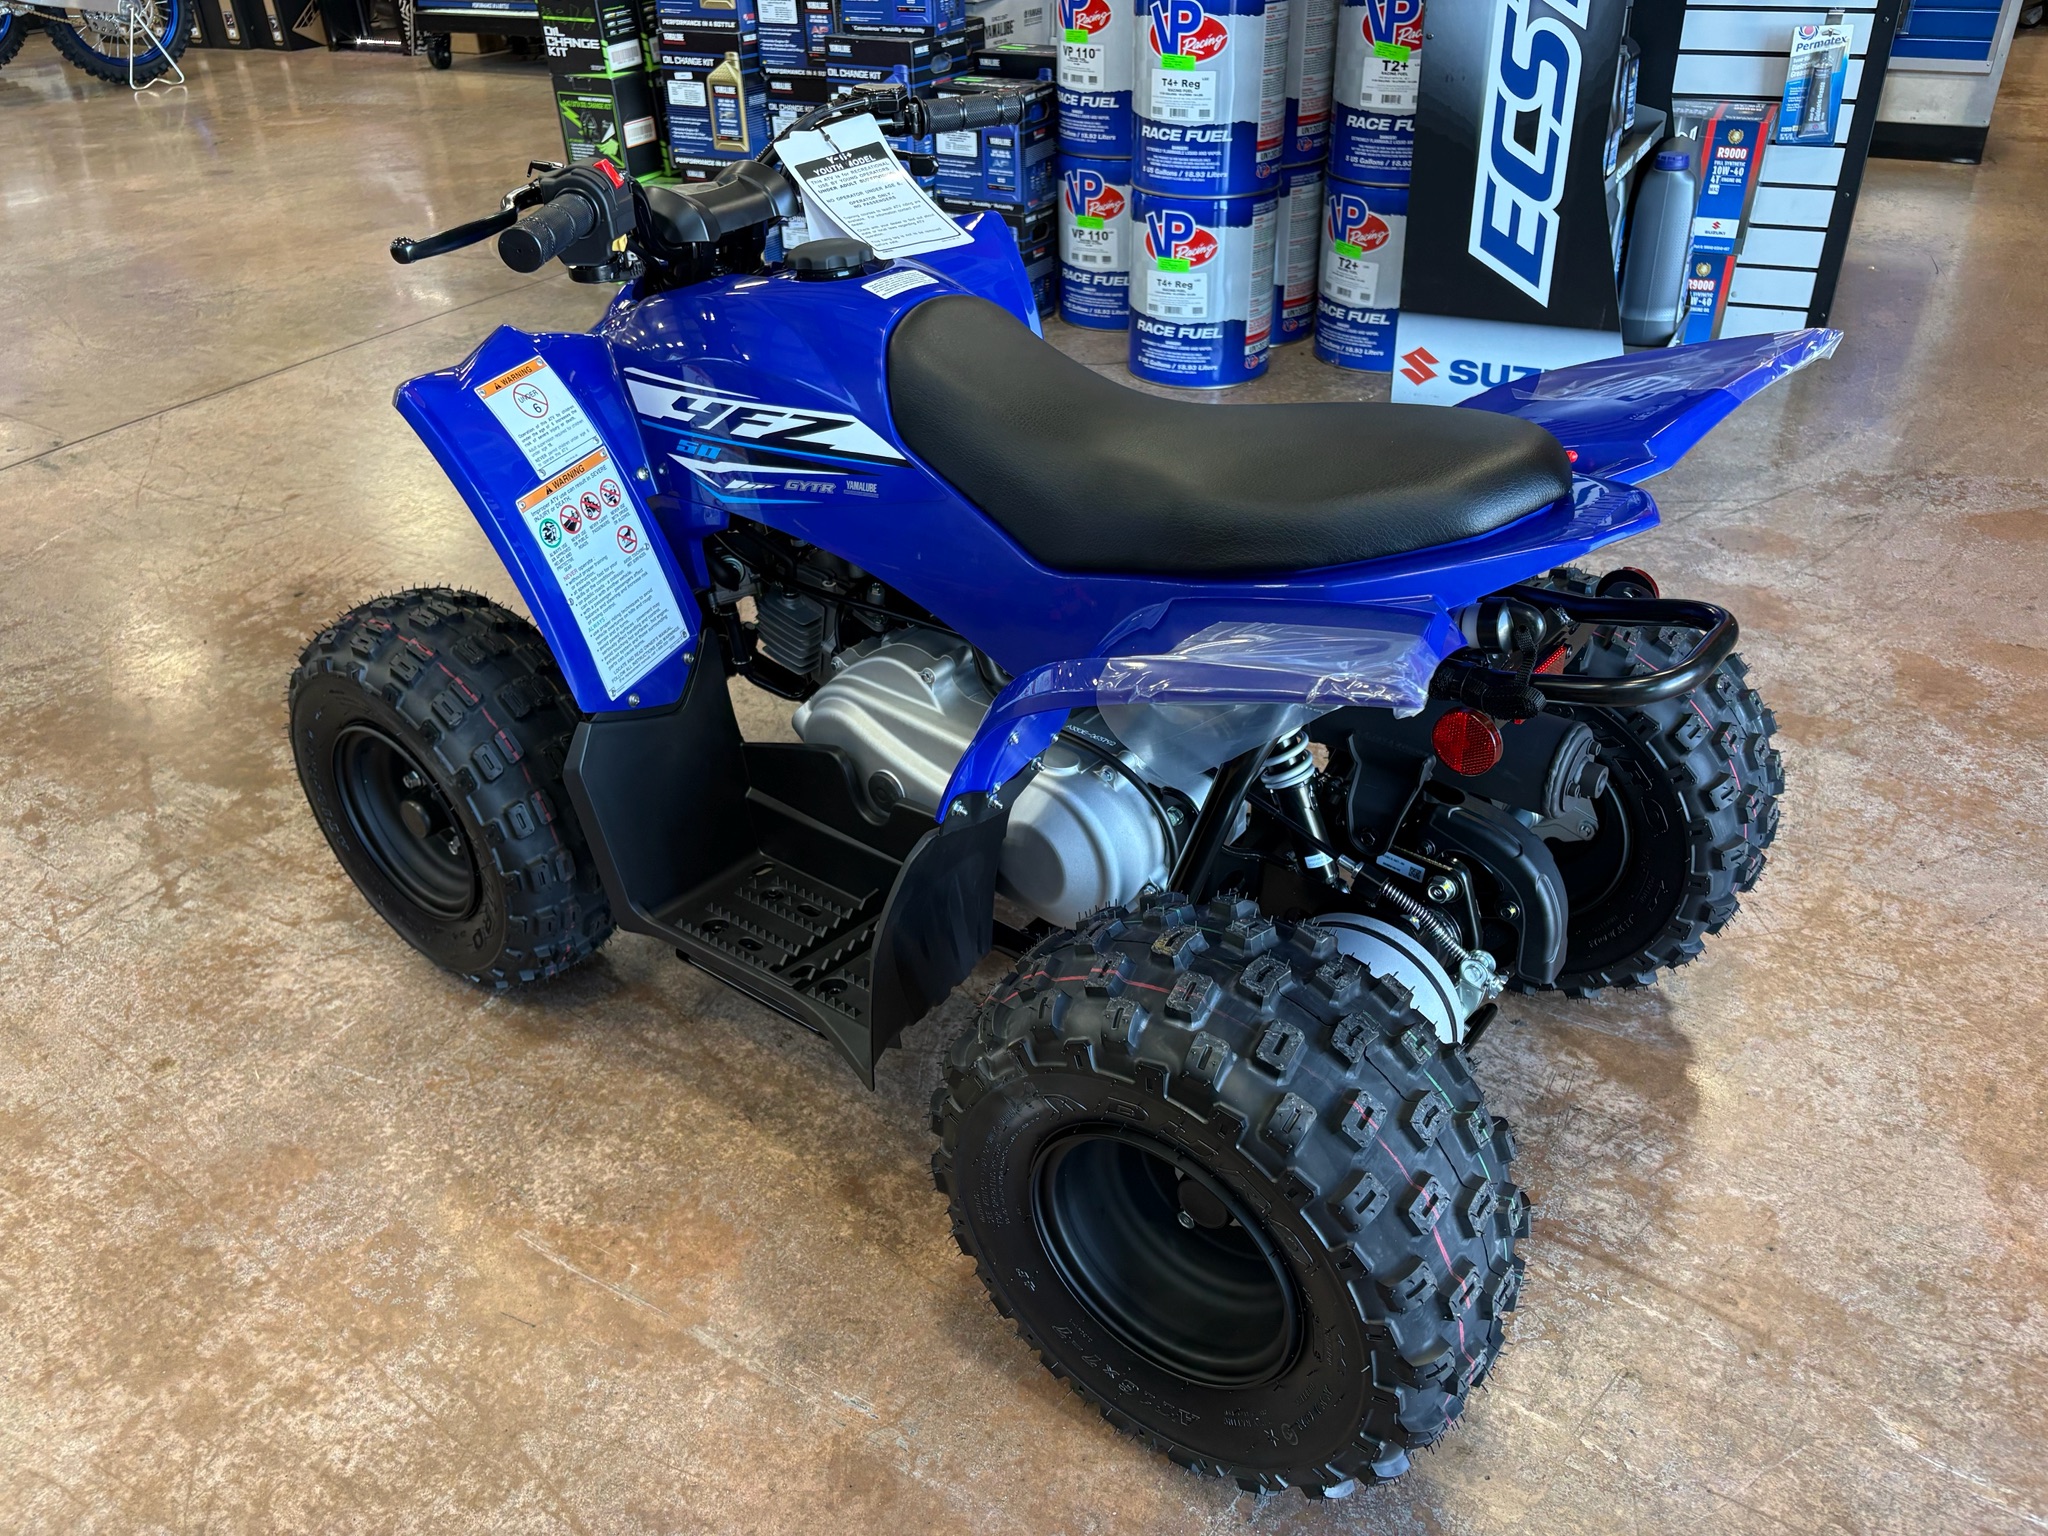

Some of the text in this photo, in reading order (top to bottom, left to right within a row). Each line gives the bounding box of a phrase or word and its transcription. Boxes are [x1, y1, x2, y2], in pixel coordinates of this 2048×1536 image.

[1076, 11, 1112, 29] Racing
[1366, 0, 1422, 44] VP
[543, 26, 566, 37] OIL
[1150, 0, 1204, 55] VP
[545, 37, 600, 49] CHANGE
[1183, 33, 1229, 55] Racing
[1795, 36, 1848, 53] Permatex
[547, 47, 568, 57] KIT
[1063, 45, 1096, 59] VP 110
[662, 56, 674, 64] OIL
[674, 57, 703, 66] CHANGE
[1382, 60, 1408, 72] T2+
[828, 69, 882, 80] OIL CHANGE KIT
[1162, 78, 1201, 90] T4+ Reg
[778, 104, 803, 112] CHANGE
[1080, 96, 1120, 108] FUEL
[1346, 115, 1416, 132] RACE FU
[1142, 125, 1233, 143] RACE FUEL
[1717, 147, 1748, 159] R9000
[813, 163, 843, 175] YOUTH
[850, 161, 889, 173] RECREATIONAL
[1359, 158, 1385, 166] Gallons
[858, 166, 889, 177] OPERATORS
[1155, 167, 1178, 176] Gallons
[1206, 171, 1228, 179] Liters
[1712, 166, 1745, 176] 10W-40
[839, 180, 857, 188] ADULT
[1710, 174, 1721, 184] 4T
[835, 191, 863, 200] OPERATOR
[1065, 169, 1105, 216] VP
[848, 195, 875, 205] OPERATOR
[862, 195, 896, 206] PASSENGERS
[1089, 197, 1126, 216] Racing
[1329, 194, 1369, 244] VP
[1071, 229, 1109, 241] VP 110
[1145, 210, 1196, 259] VP
[1350, 229, 1391, 247] Racing
[1176, 243, 1219, 261] Racing
[1338, 256, 1359, 271] T2+
[1062, 268, 1130, 287] RACE FUEL
[1157, 278, 1193, 291] T4+ Reg
[1347, 311, 1391, 325] FUEL
[1137, 319, 1224, 339] RACE FUEL
[500, 366, 532, 385] WARNING
[1449, 359, 1548, 388] SUZ
[517, 389, 538, 403] UNDER
[532, 402, 542, 413] 6
[517, 427, 534, 438] Operation
[561, 404, 574, 414] children
[521, 435, 531, 443] under
[555, 413, 571, 423] increases
[671, 396, 856, 447] YFZ
[537, 431, 549, 439] severe
[675, 439, 722, 460] 50
[552, 464, 584, 488] WARNING
[530, 502, 549, 516] Improper
[550, 495, 558, 504] ATV
[574, 478, 586, 488] result
[590, 464, 607, 478] SEVERE
[783, 479, 837, 494] GYTR
[845, 480, 878, 493] YAMALUBE
[533, 508, 550, 522] INJURY
[554, 495, 571, 508] DEATH.
[562, 568, 578, 580] NEVER
